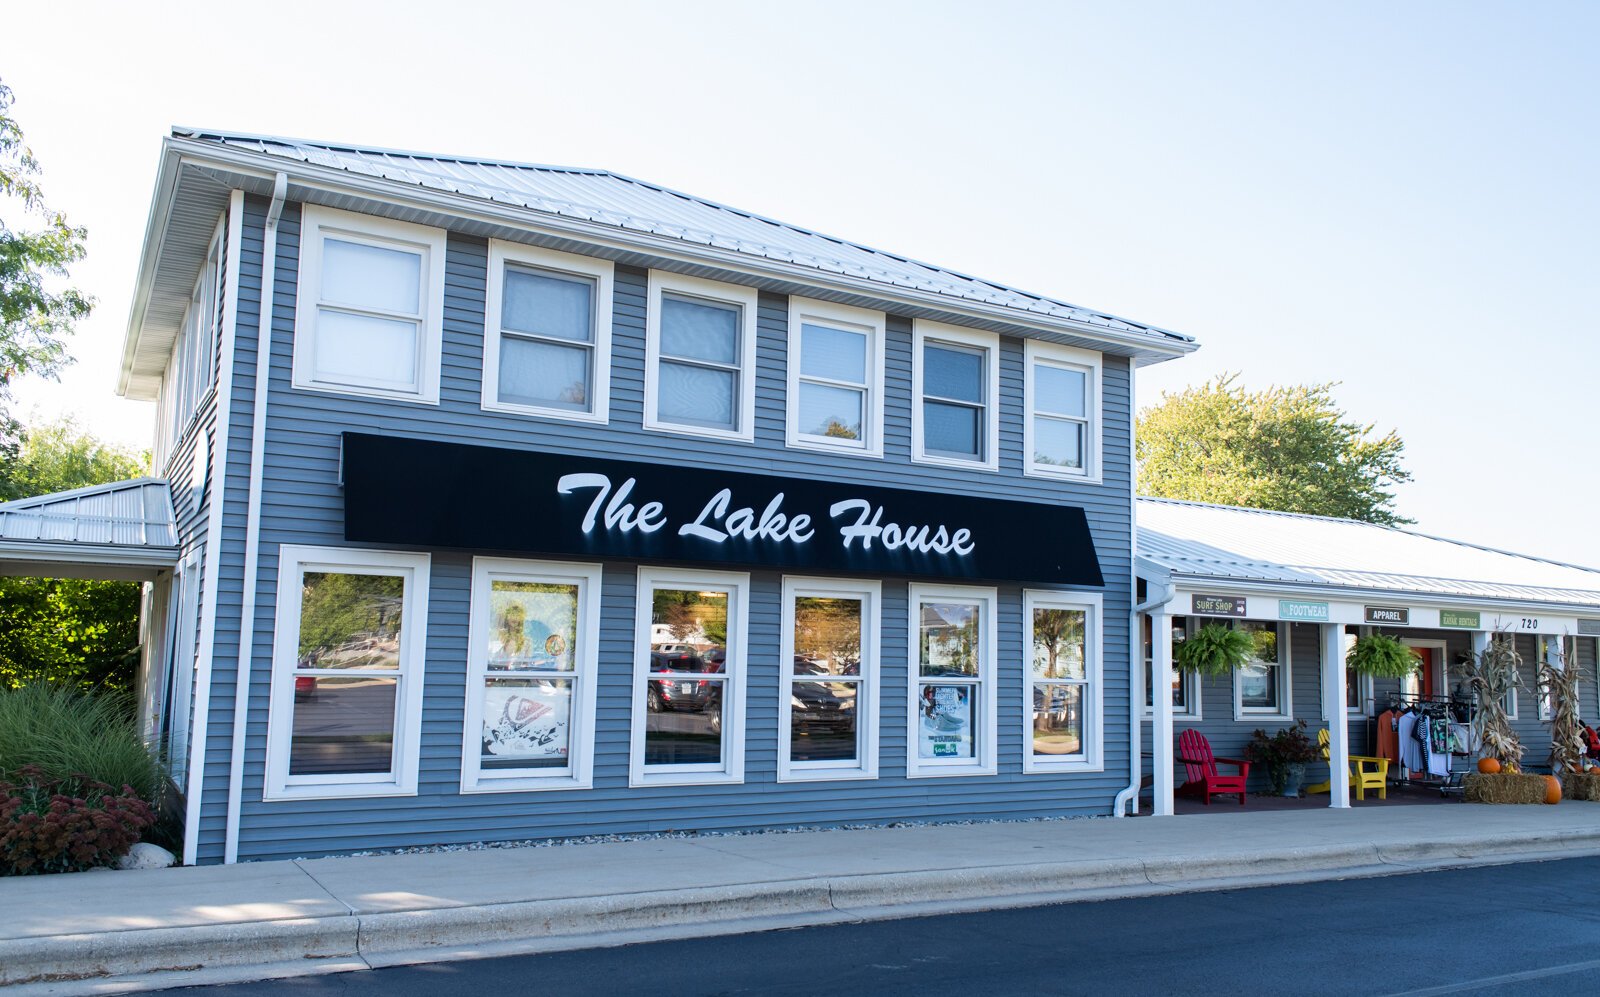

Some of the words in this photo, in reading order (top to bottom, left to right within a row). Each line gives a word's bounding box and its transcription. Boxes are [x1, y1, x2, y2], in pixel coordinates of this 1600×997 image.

[557, 473, 668, 534] The
[678, 488, 815, 543] Lake
[830, 499, 976, 556] House
[1196, 600, 1214, 609] SURF
[1216, 602, 1232, 610] SHOP
[1289, 604, 1327, 617] FOOTWEAR
[1372, 610, 1401, 620] APPAREL
[1459, 618, 1477, 626] RENTALS
[1522, 618, 1538, 630] 720
